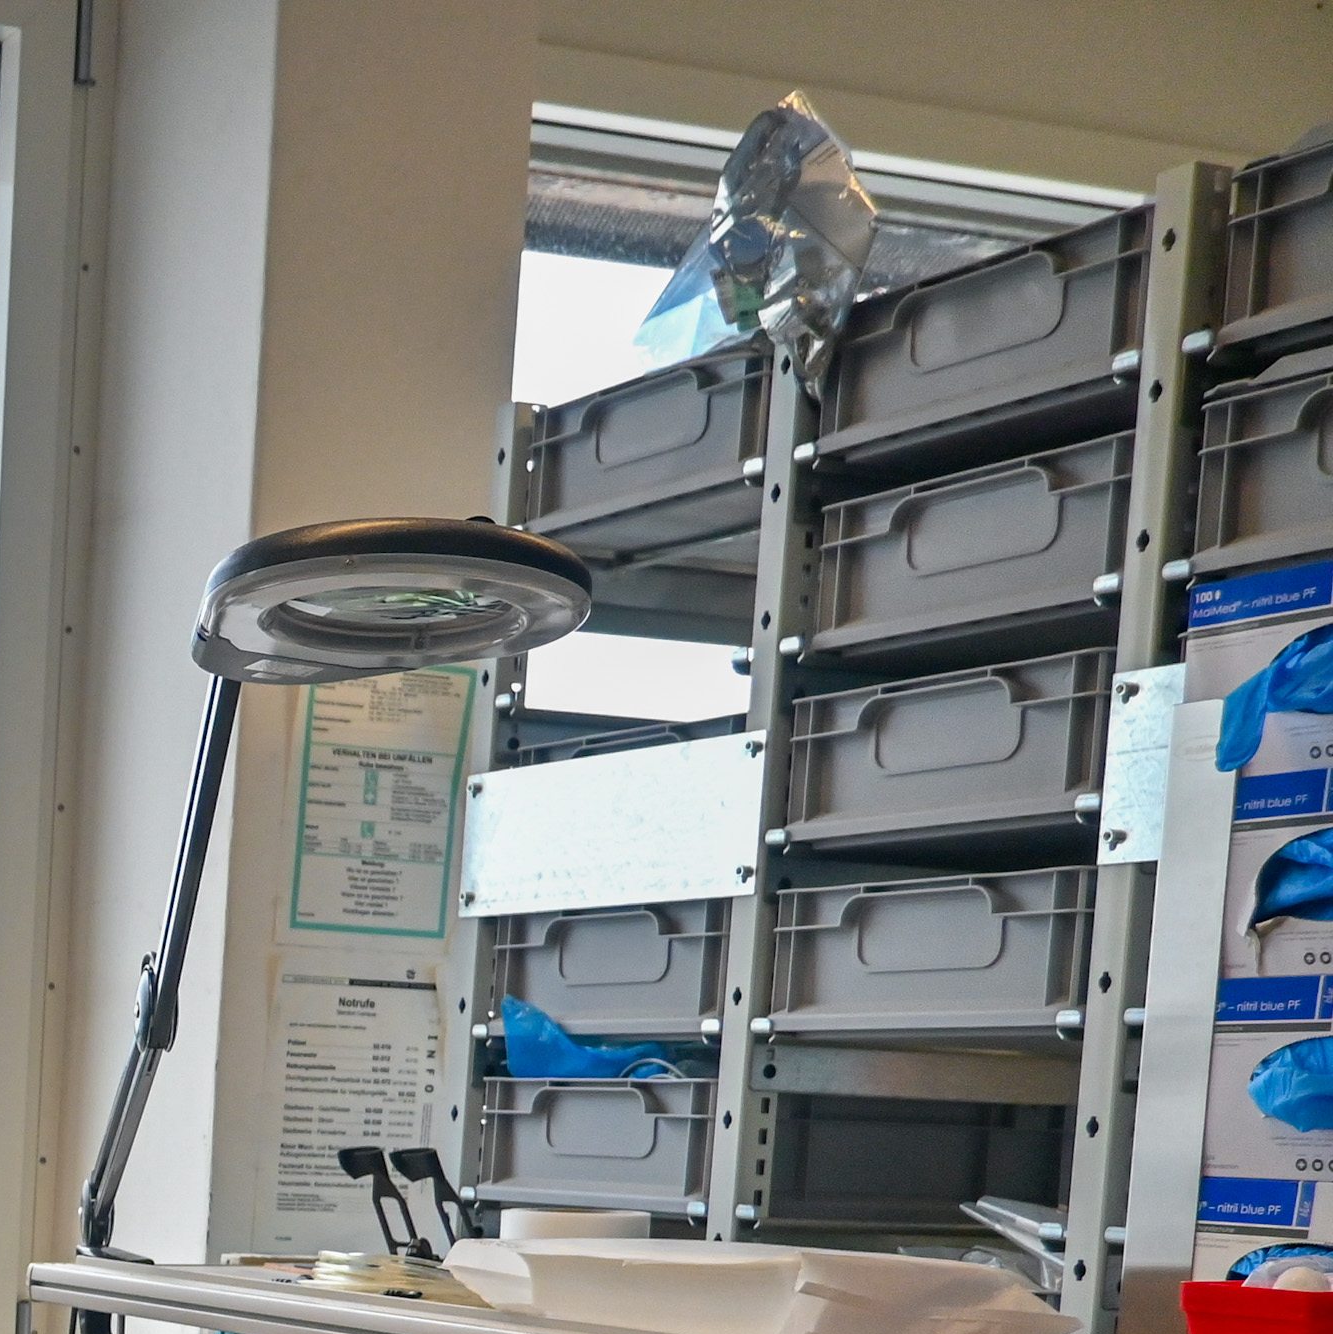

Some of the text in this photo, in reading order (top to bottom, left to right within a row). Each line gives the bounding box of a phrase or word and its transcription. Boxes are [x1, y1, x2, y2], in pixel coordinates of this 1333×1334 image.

[1195, 591, 1213, 604] 100
[1251, 595, 1274, 609] nitril
[1275, 592, 1300, 605] blue
[1302, 587, 1317, 599] PF
[1243, 798, 1266, 811] nitril
[1267, 797, 1292, 809] blue
[1295, 794, 1308, 805] PF
[338, 997, 375, 1009] Notrufe
[1236, 1001, 1258, 1012] nitril
[1260, 1001, 1284, 1011] blue
[1287, 1000, 1301, 1011] PF
[1217, 1202, 1238, 1213] nitril
[1240, 1203, 1265, 1215] blue
[1267, 1205, 1281, 1215] PF
